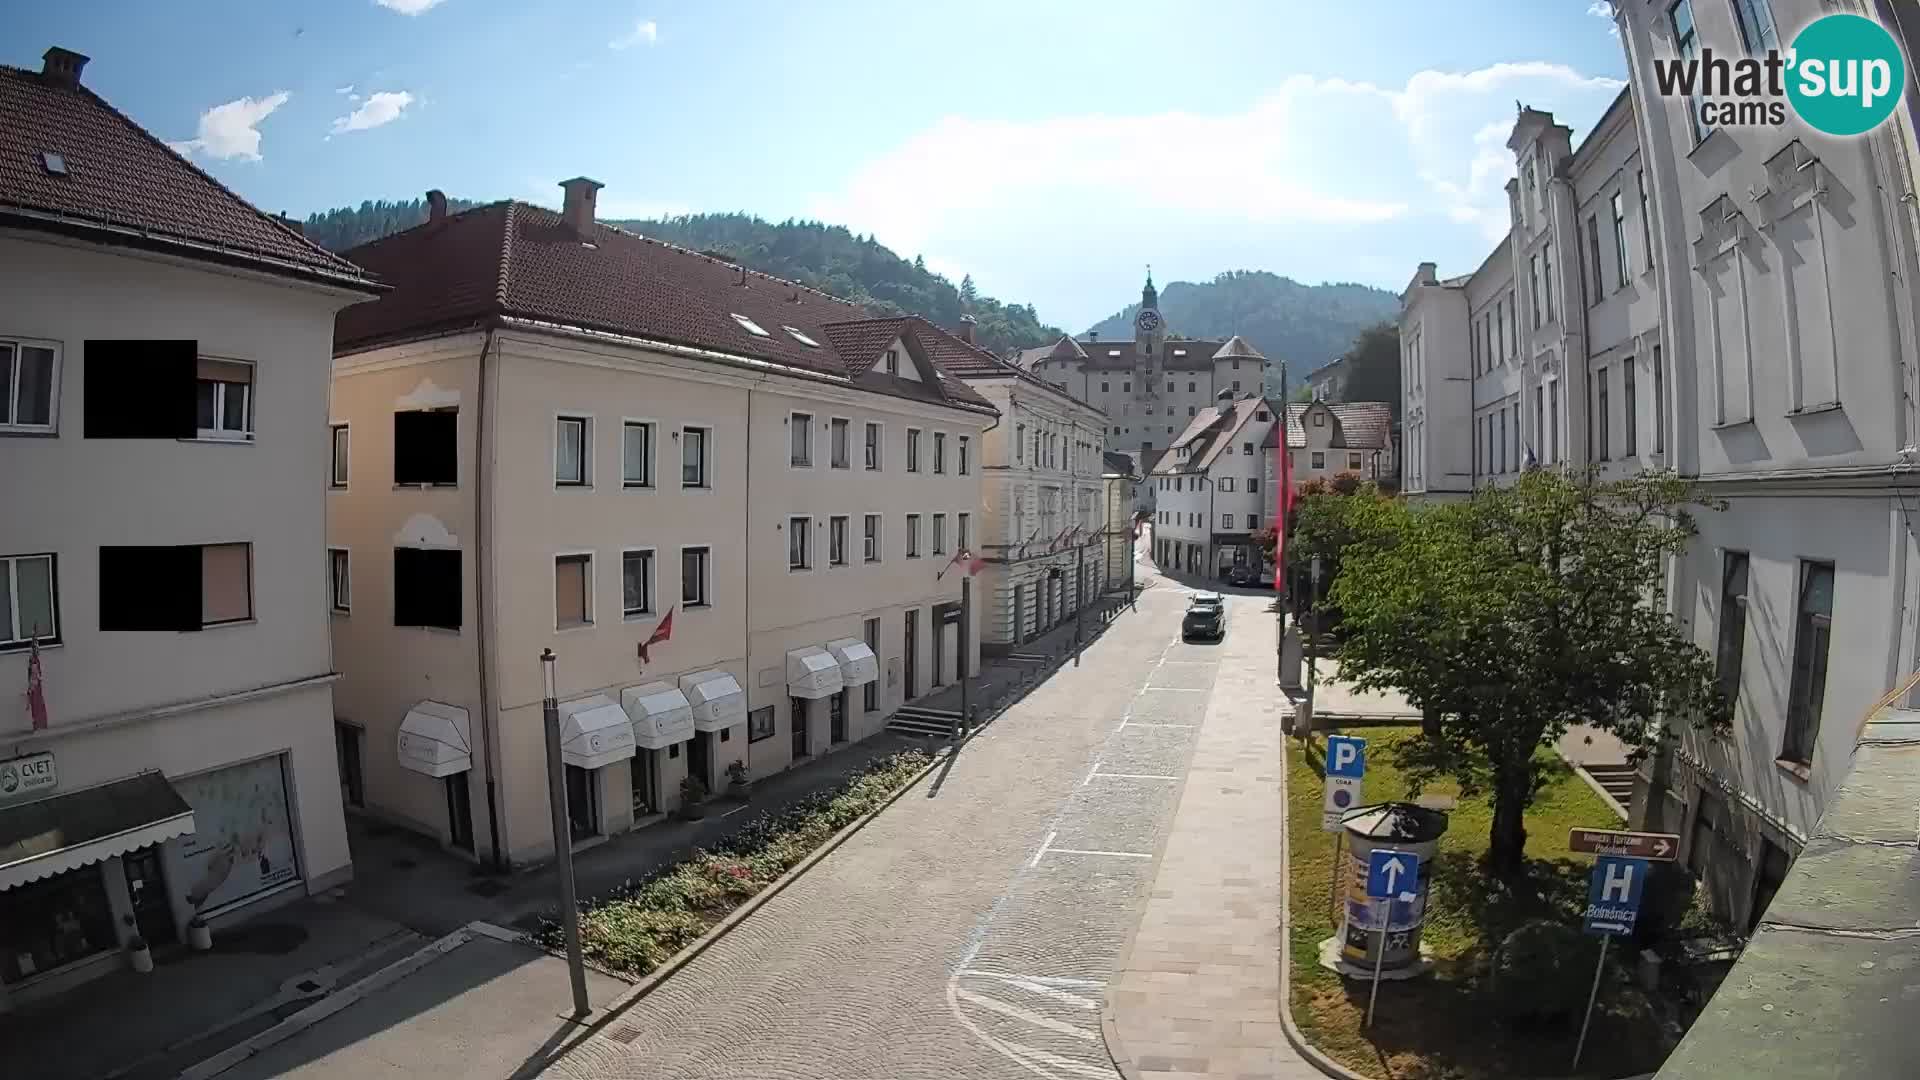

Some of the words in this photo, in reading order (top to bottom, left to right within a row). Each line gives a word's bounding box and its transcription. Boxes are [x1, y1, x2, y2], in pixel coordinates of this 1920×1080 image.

[22, 760, 50, 777] CVET
[1335, 743, 1356, 771] P
[1601, 863, 1633, 903] H
